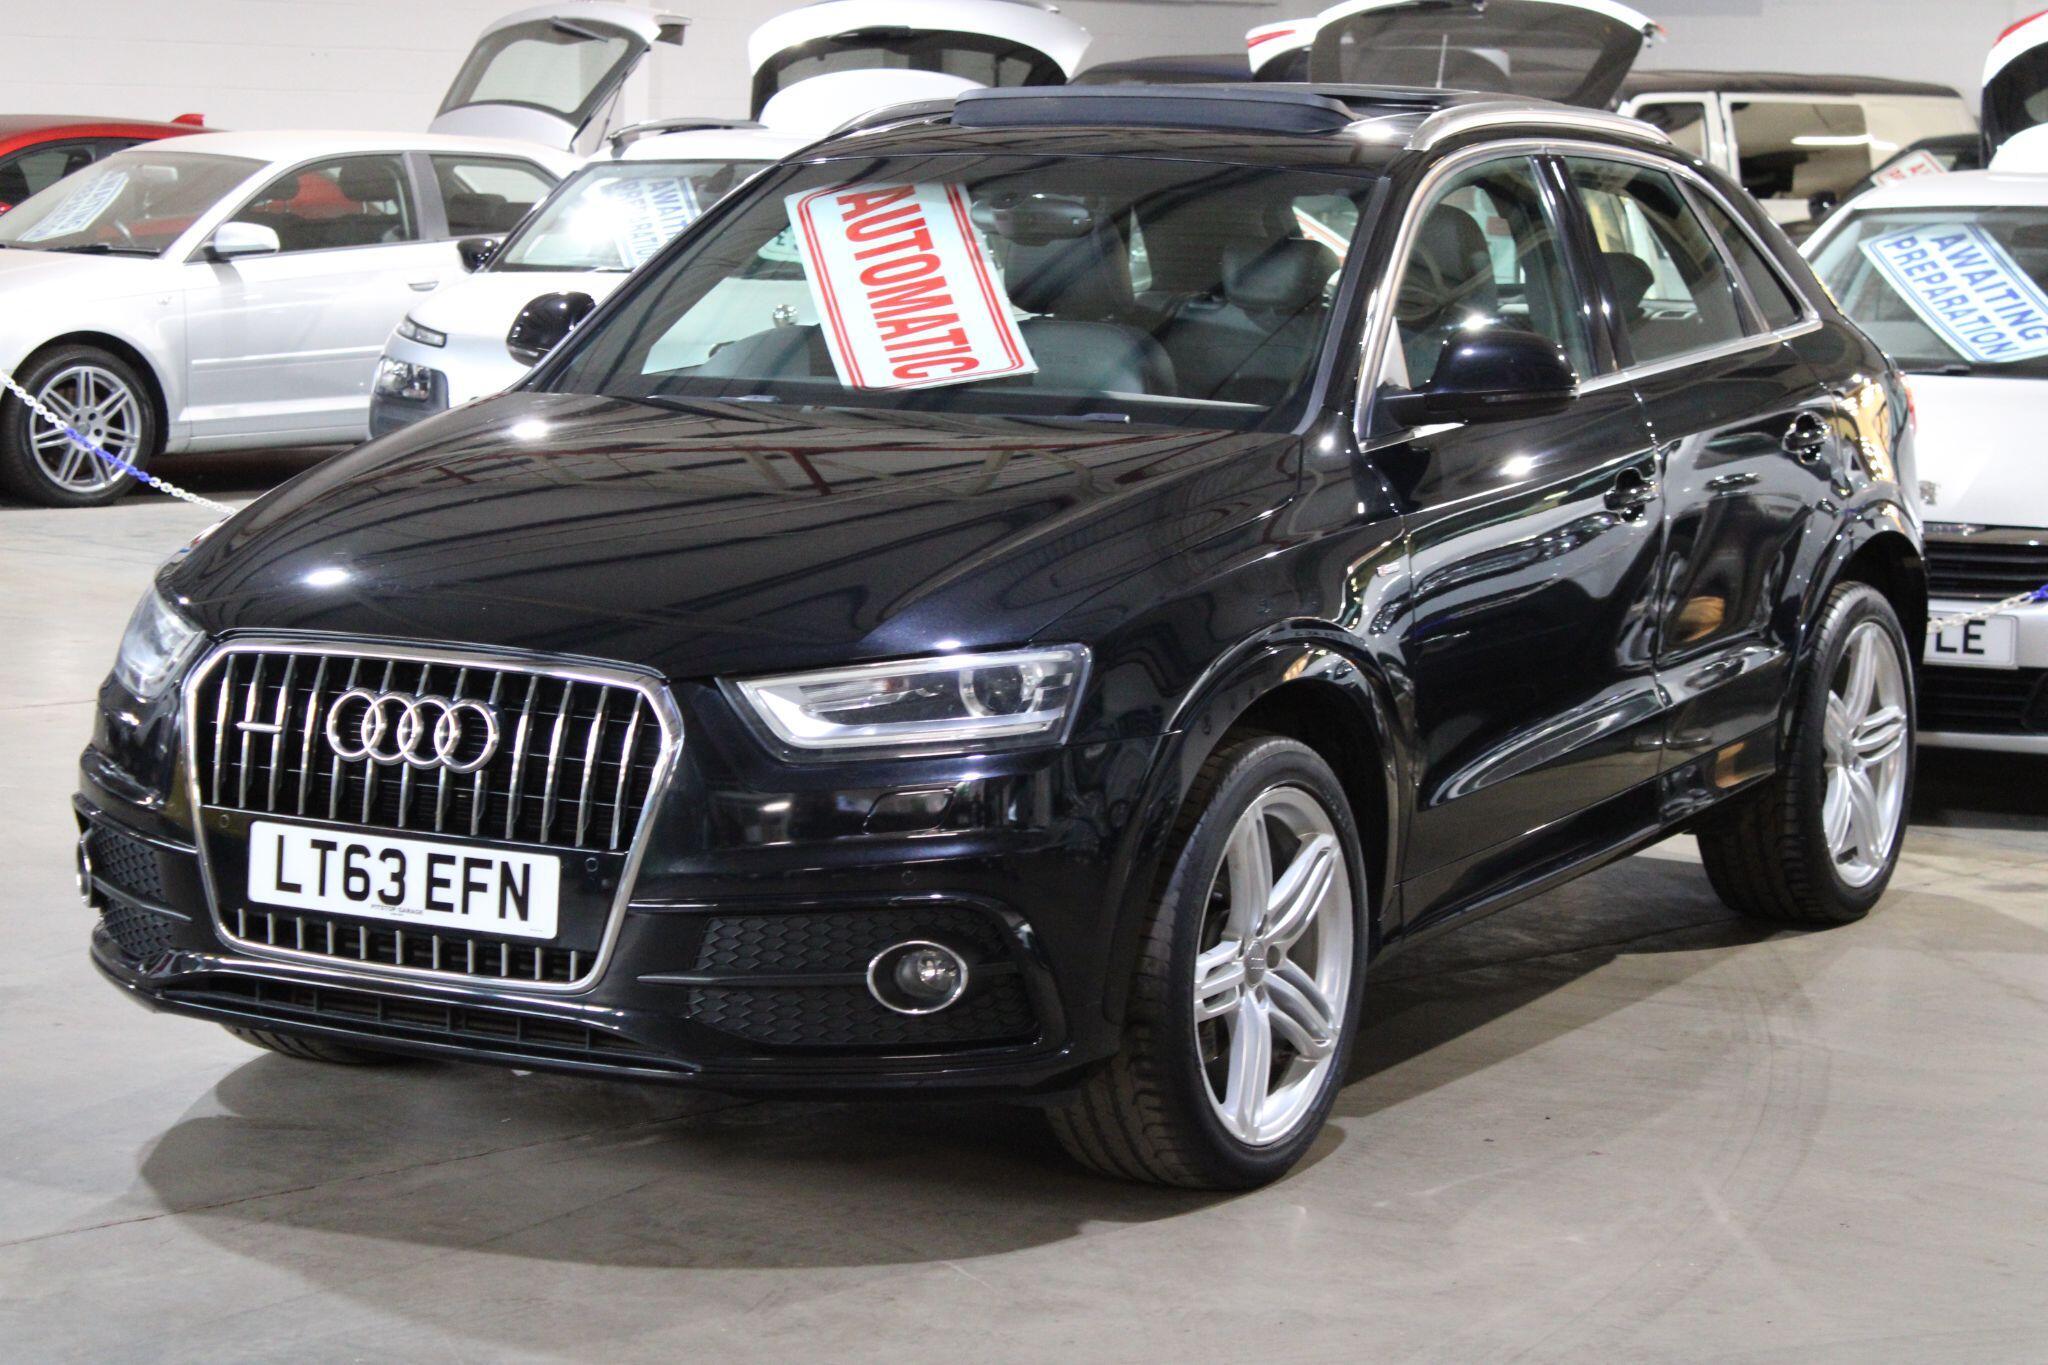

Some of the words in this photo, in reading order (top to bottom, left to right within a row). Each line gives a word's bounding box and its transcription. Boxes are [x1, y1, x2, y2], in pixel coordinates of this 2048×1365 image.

[836, 184, 980, 380] AUTOMATIC
[1883, 236, 2020, 356] PREPARATION
[1930, 233, 2048, 341] AWAITING
[1928, 617, 1986, 655] LE
[275, 835, 407, 906] LT63
[425, 852, 531, 922] EFN
